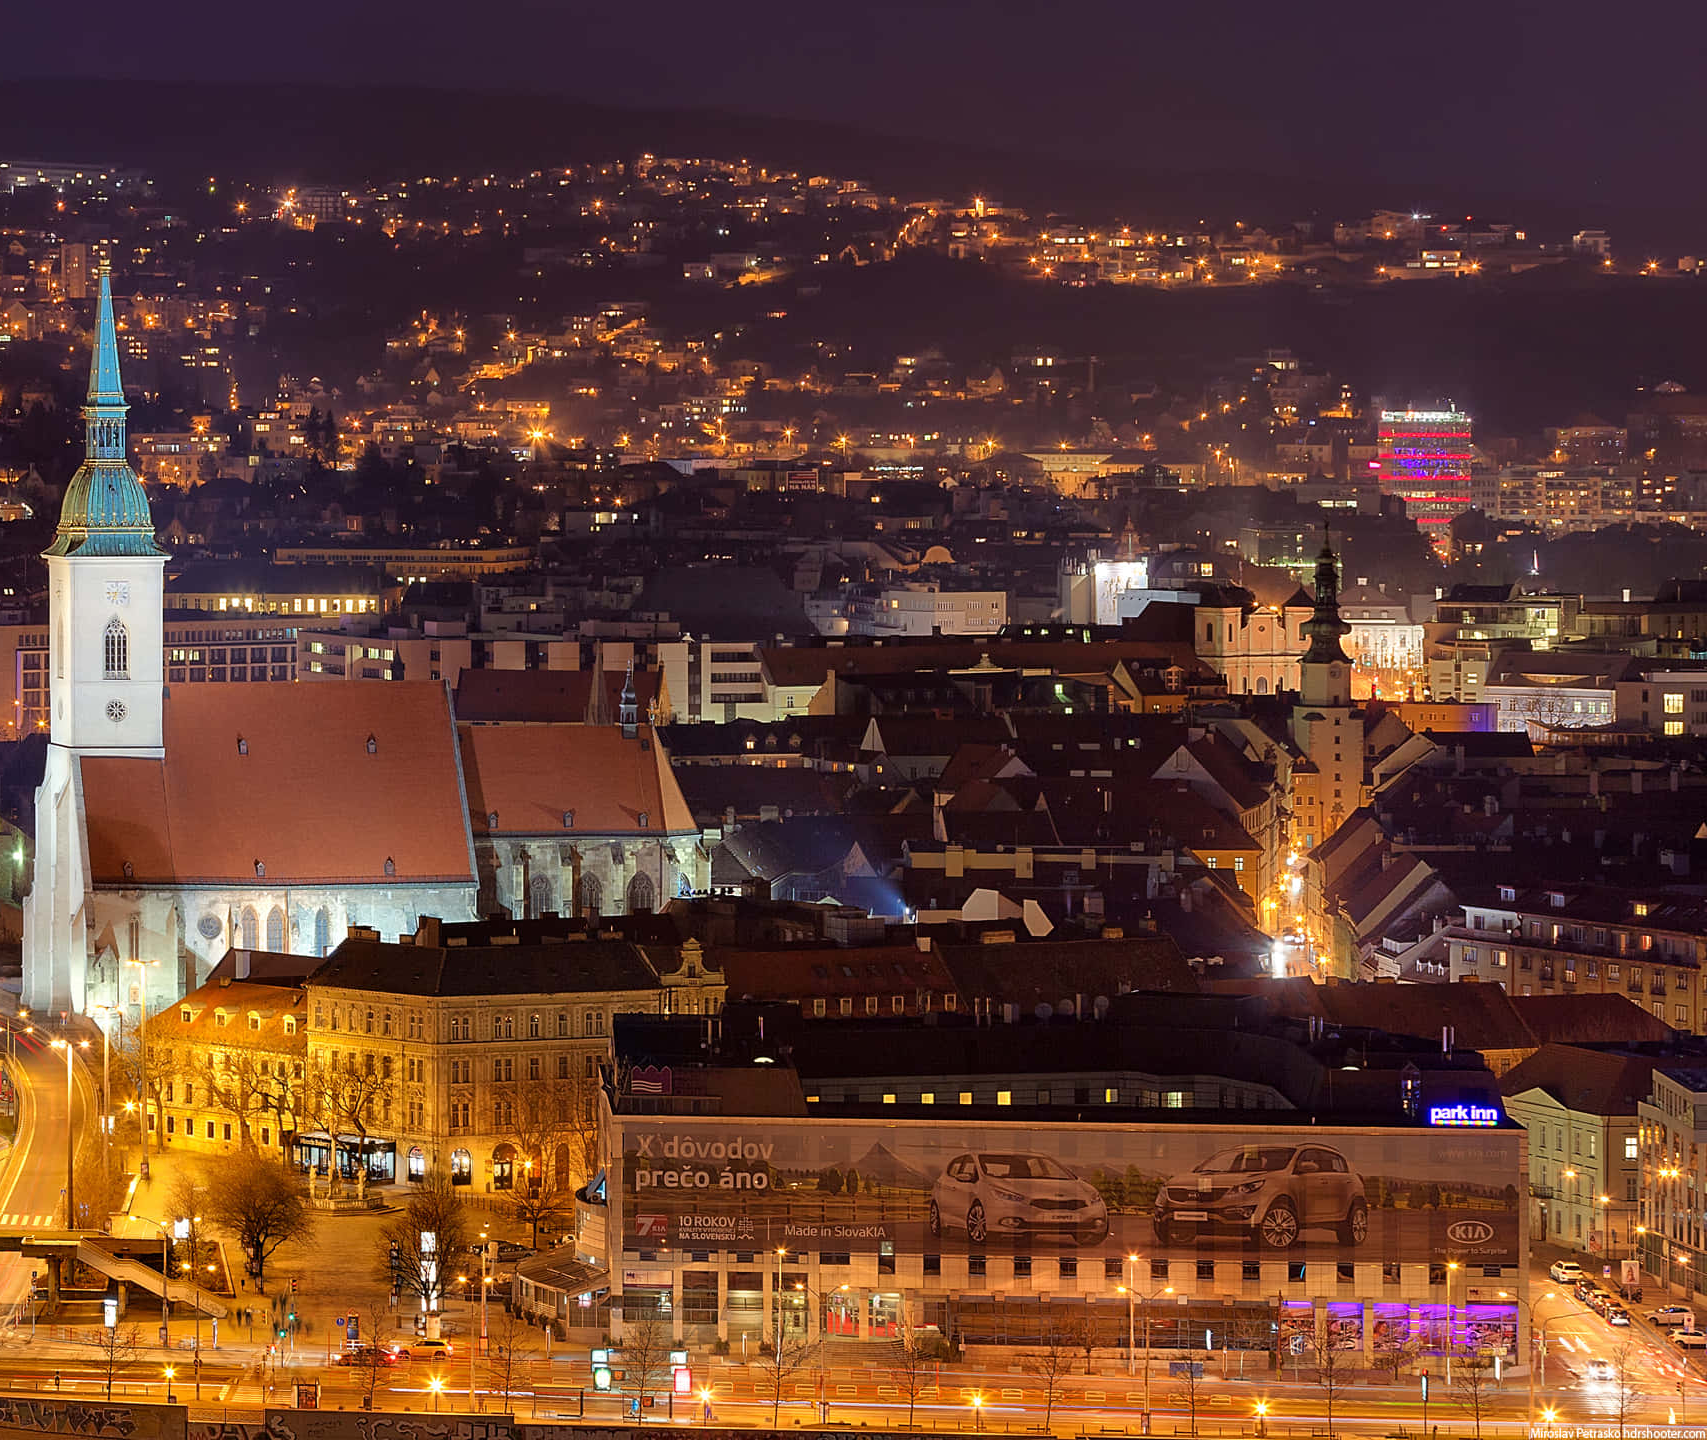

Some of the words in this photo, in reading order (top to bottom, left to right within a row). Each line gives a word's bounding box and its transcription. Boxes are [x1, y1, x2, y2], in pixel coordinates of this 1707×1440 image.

[1431, 1105, 1469, 1123] park
[1471, 1106, 1497, 1120] inn
[664, 1134, 774, 1159] dôvodov
[635, 1165, 710, 1191] prečo
[719, 1165, 768, 1189] áno
[637, 1217, 654, 1236] 7
[679, 1216, 692, 1226] 10
[694, 1216, 736, 1227] ROKOV
[691, 1232, 736, 1240] SLOVENSKU
[785, 1225, 818, 1237] Made
[821, 1225, 831, 1237] in
[835, 1225, 886, 1238] SlovaKIA
[1455, 1226, 1486, 1238] KIA
